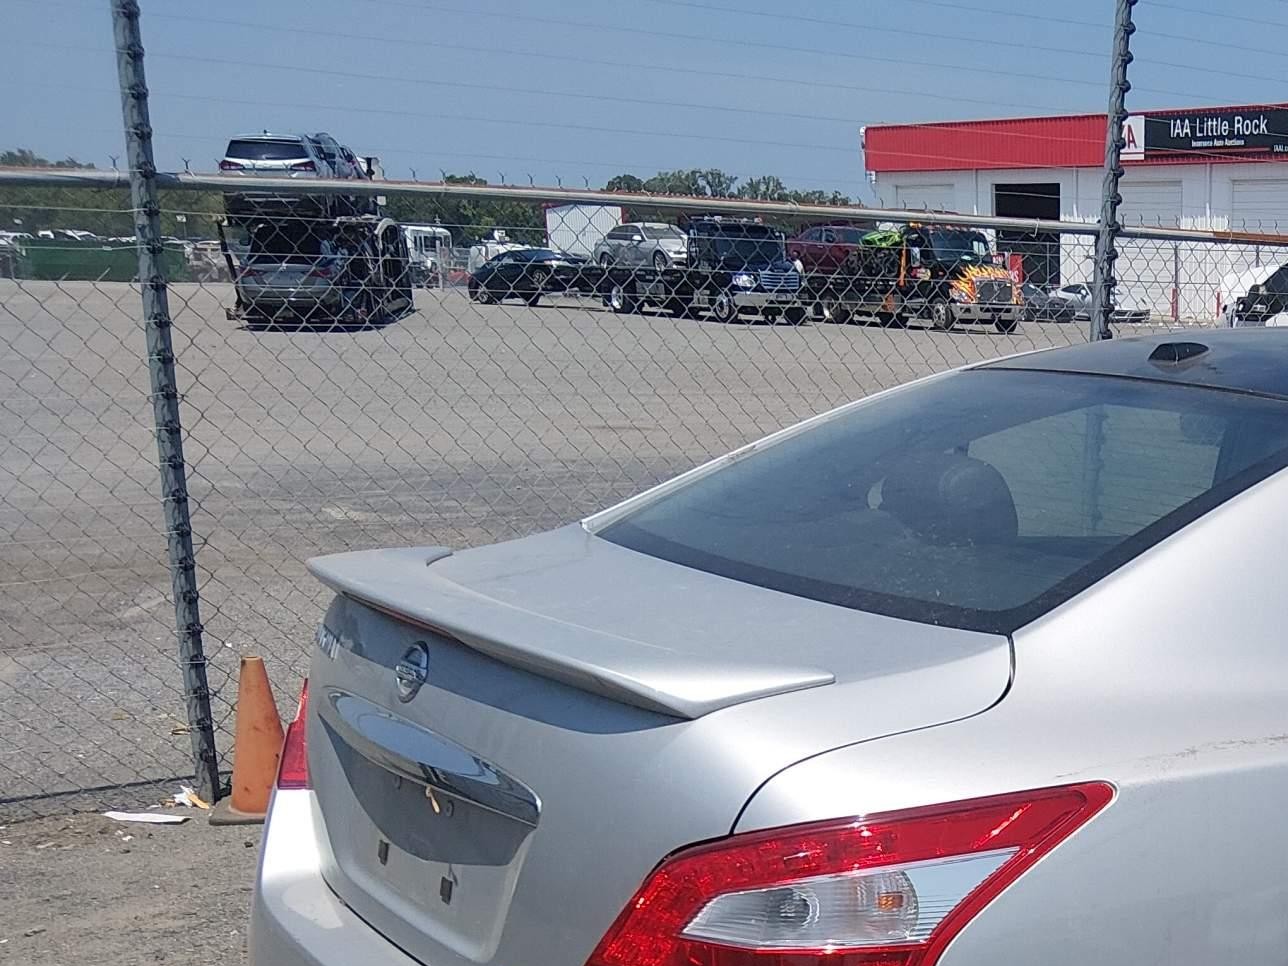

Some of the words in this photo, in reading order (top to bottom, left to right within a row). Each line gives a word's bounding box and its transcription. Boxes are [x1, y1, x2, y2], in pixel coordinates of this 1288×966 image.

[1170, 118, 1191, 138] IAA
[1196, 117, 1229, 137] Little
[1234, 115, 1268, 135] Rock
